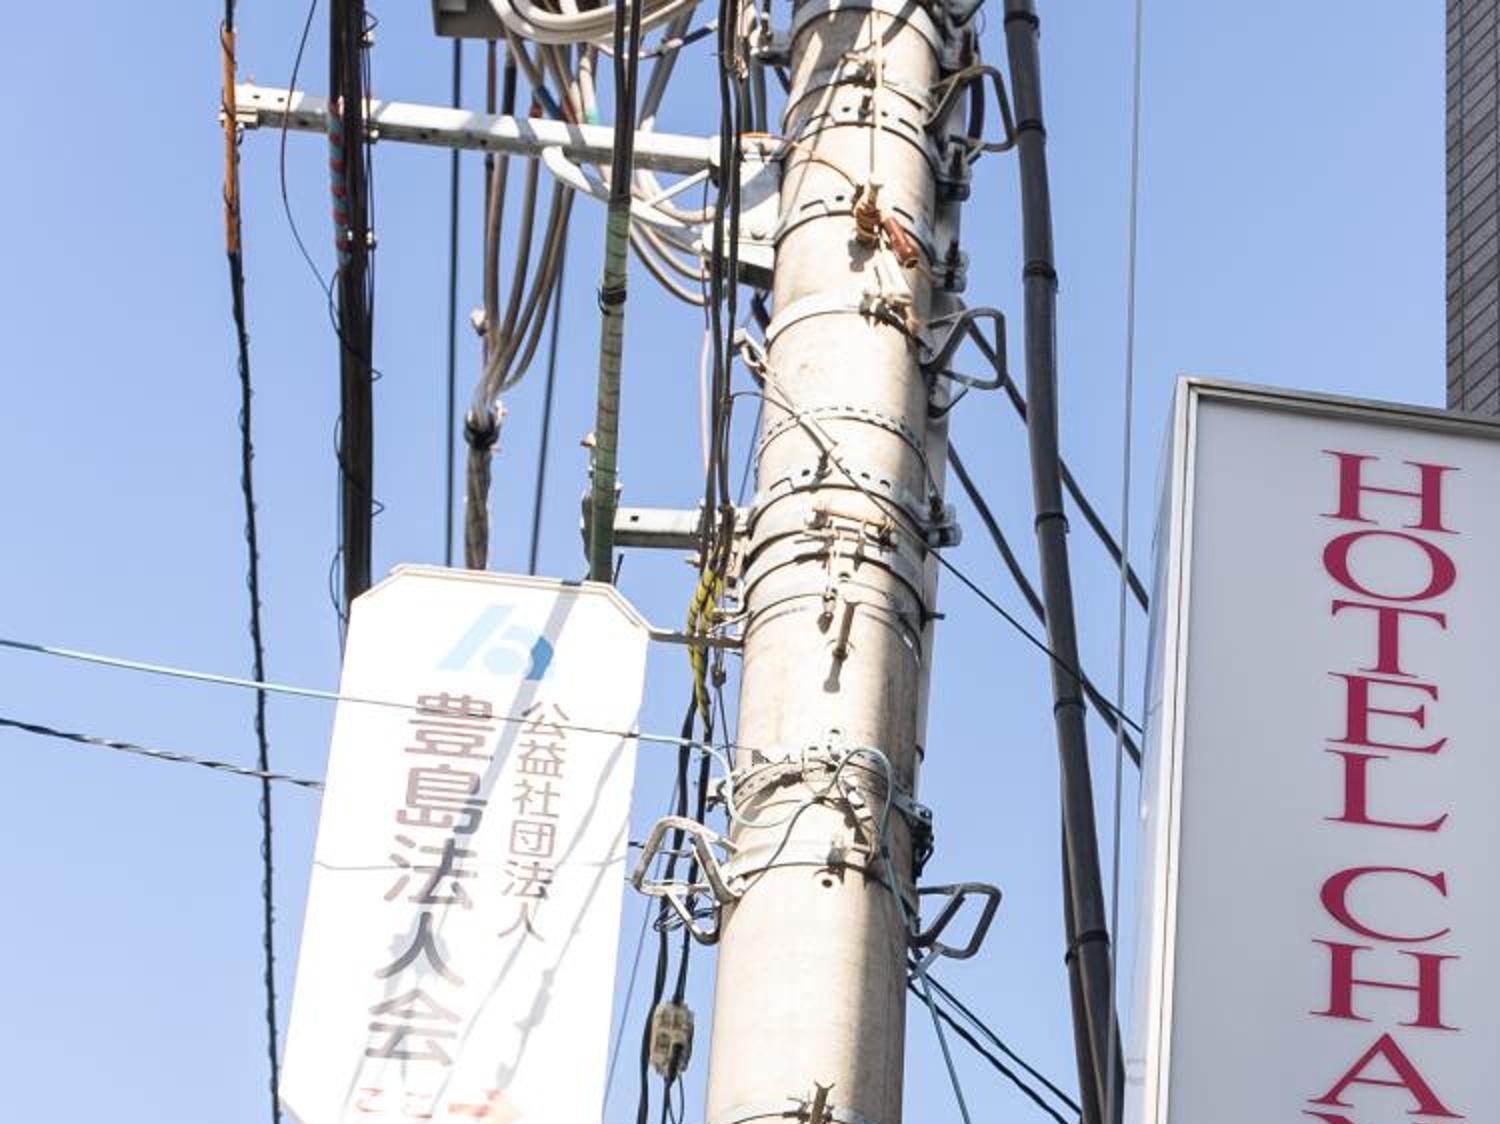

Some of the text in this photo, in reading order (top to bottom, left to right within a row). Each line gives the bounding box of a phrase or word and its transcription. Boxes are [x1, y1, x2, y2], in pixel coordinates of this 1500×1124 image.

[497, 700, 571, 942] 公益社団法人
[1319, 449, 1462, 834] HOTEL
[364, 691, 496, 1067] 豊島法人会
